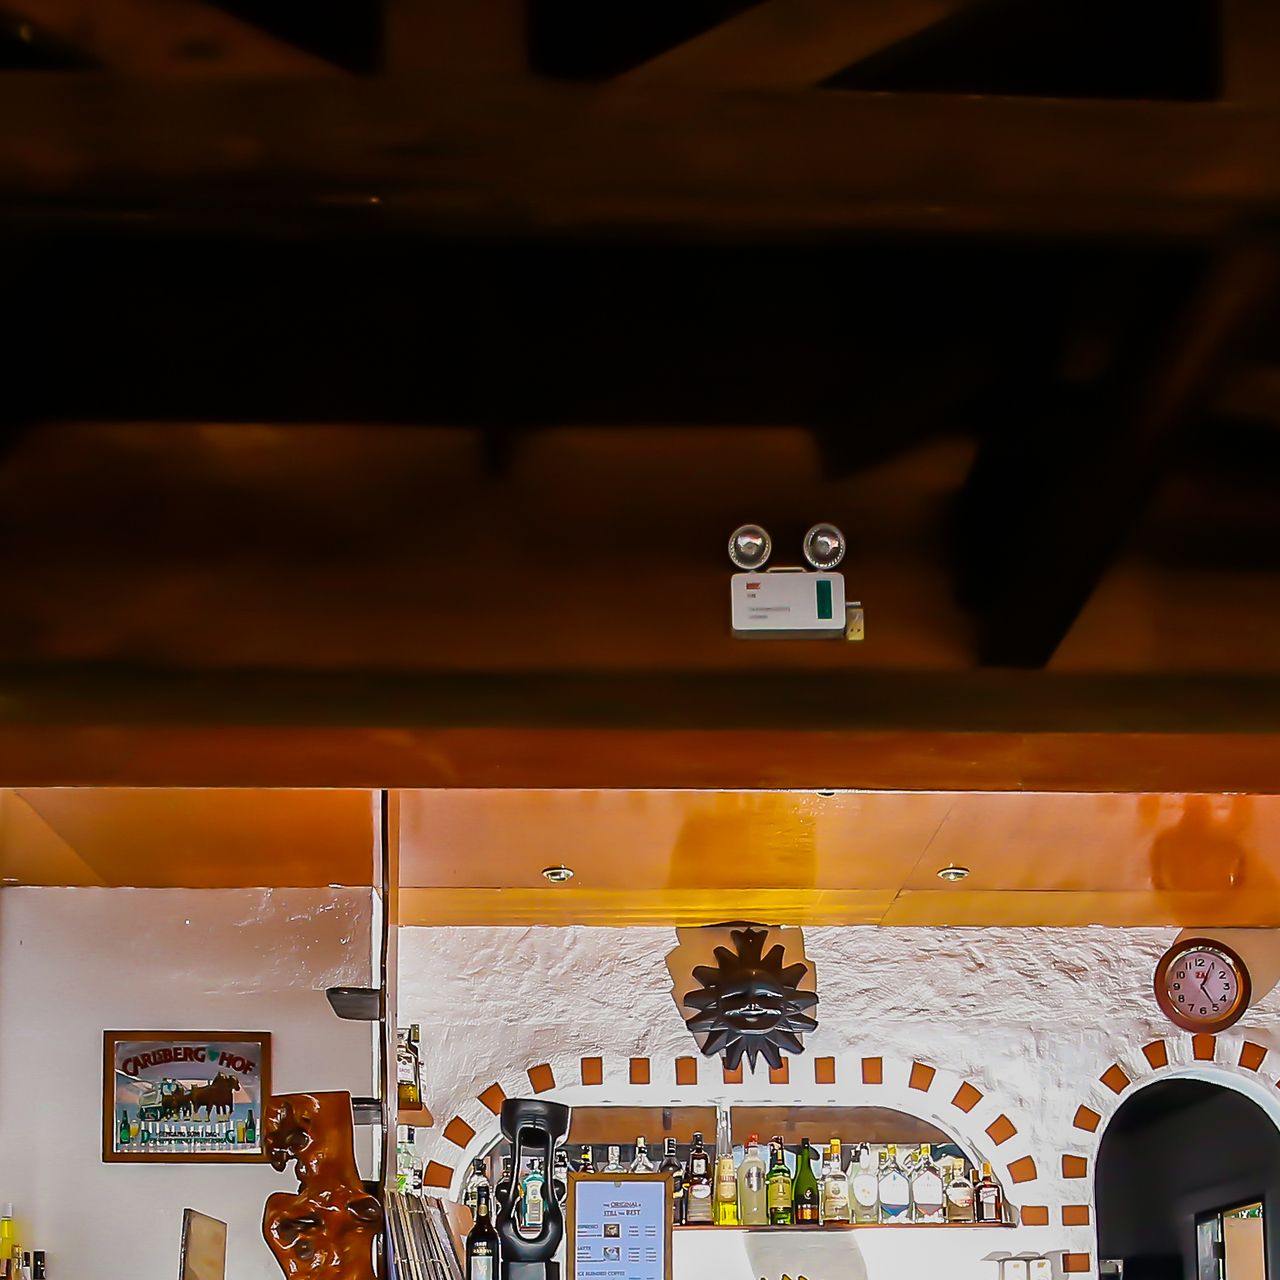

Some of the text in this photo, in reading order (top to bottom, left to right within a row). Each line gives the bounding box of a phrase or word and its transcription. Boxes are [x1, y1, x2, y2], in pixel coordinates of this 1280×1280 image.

[1185, 962, 1192, 970] 11
[1195, 959, 1205, 967] 12
[1176, 971, 1185, 979] 10
[1219, 971, 1226, 979] 2
[121, 1046, 257, 1077] CARLSBERG HOF
